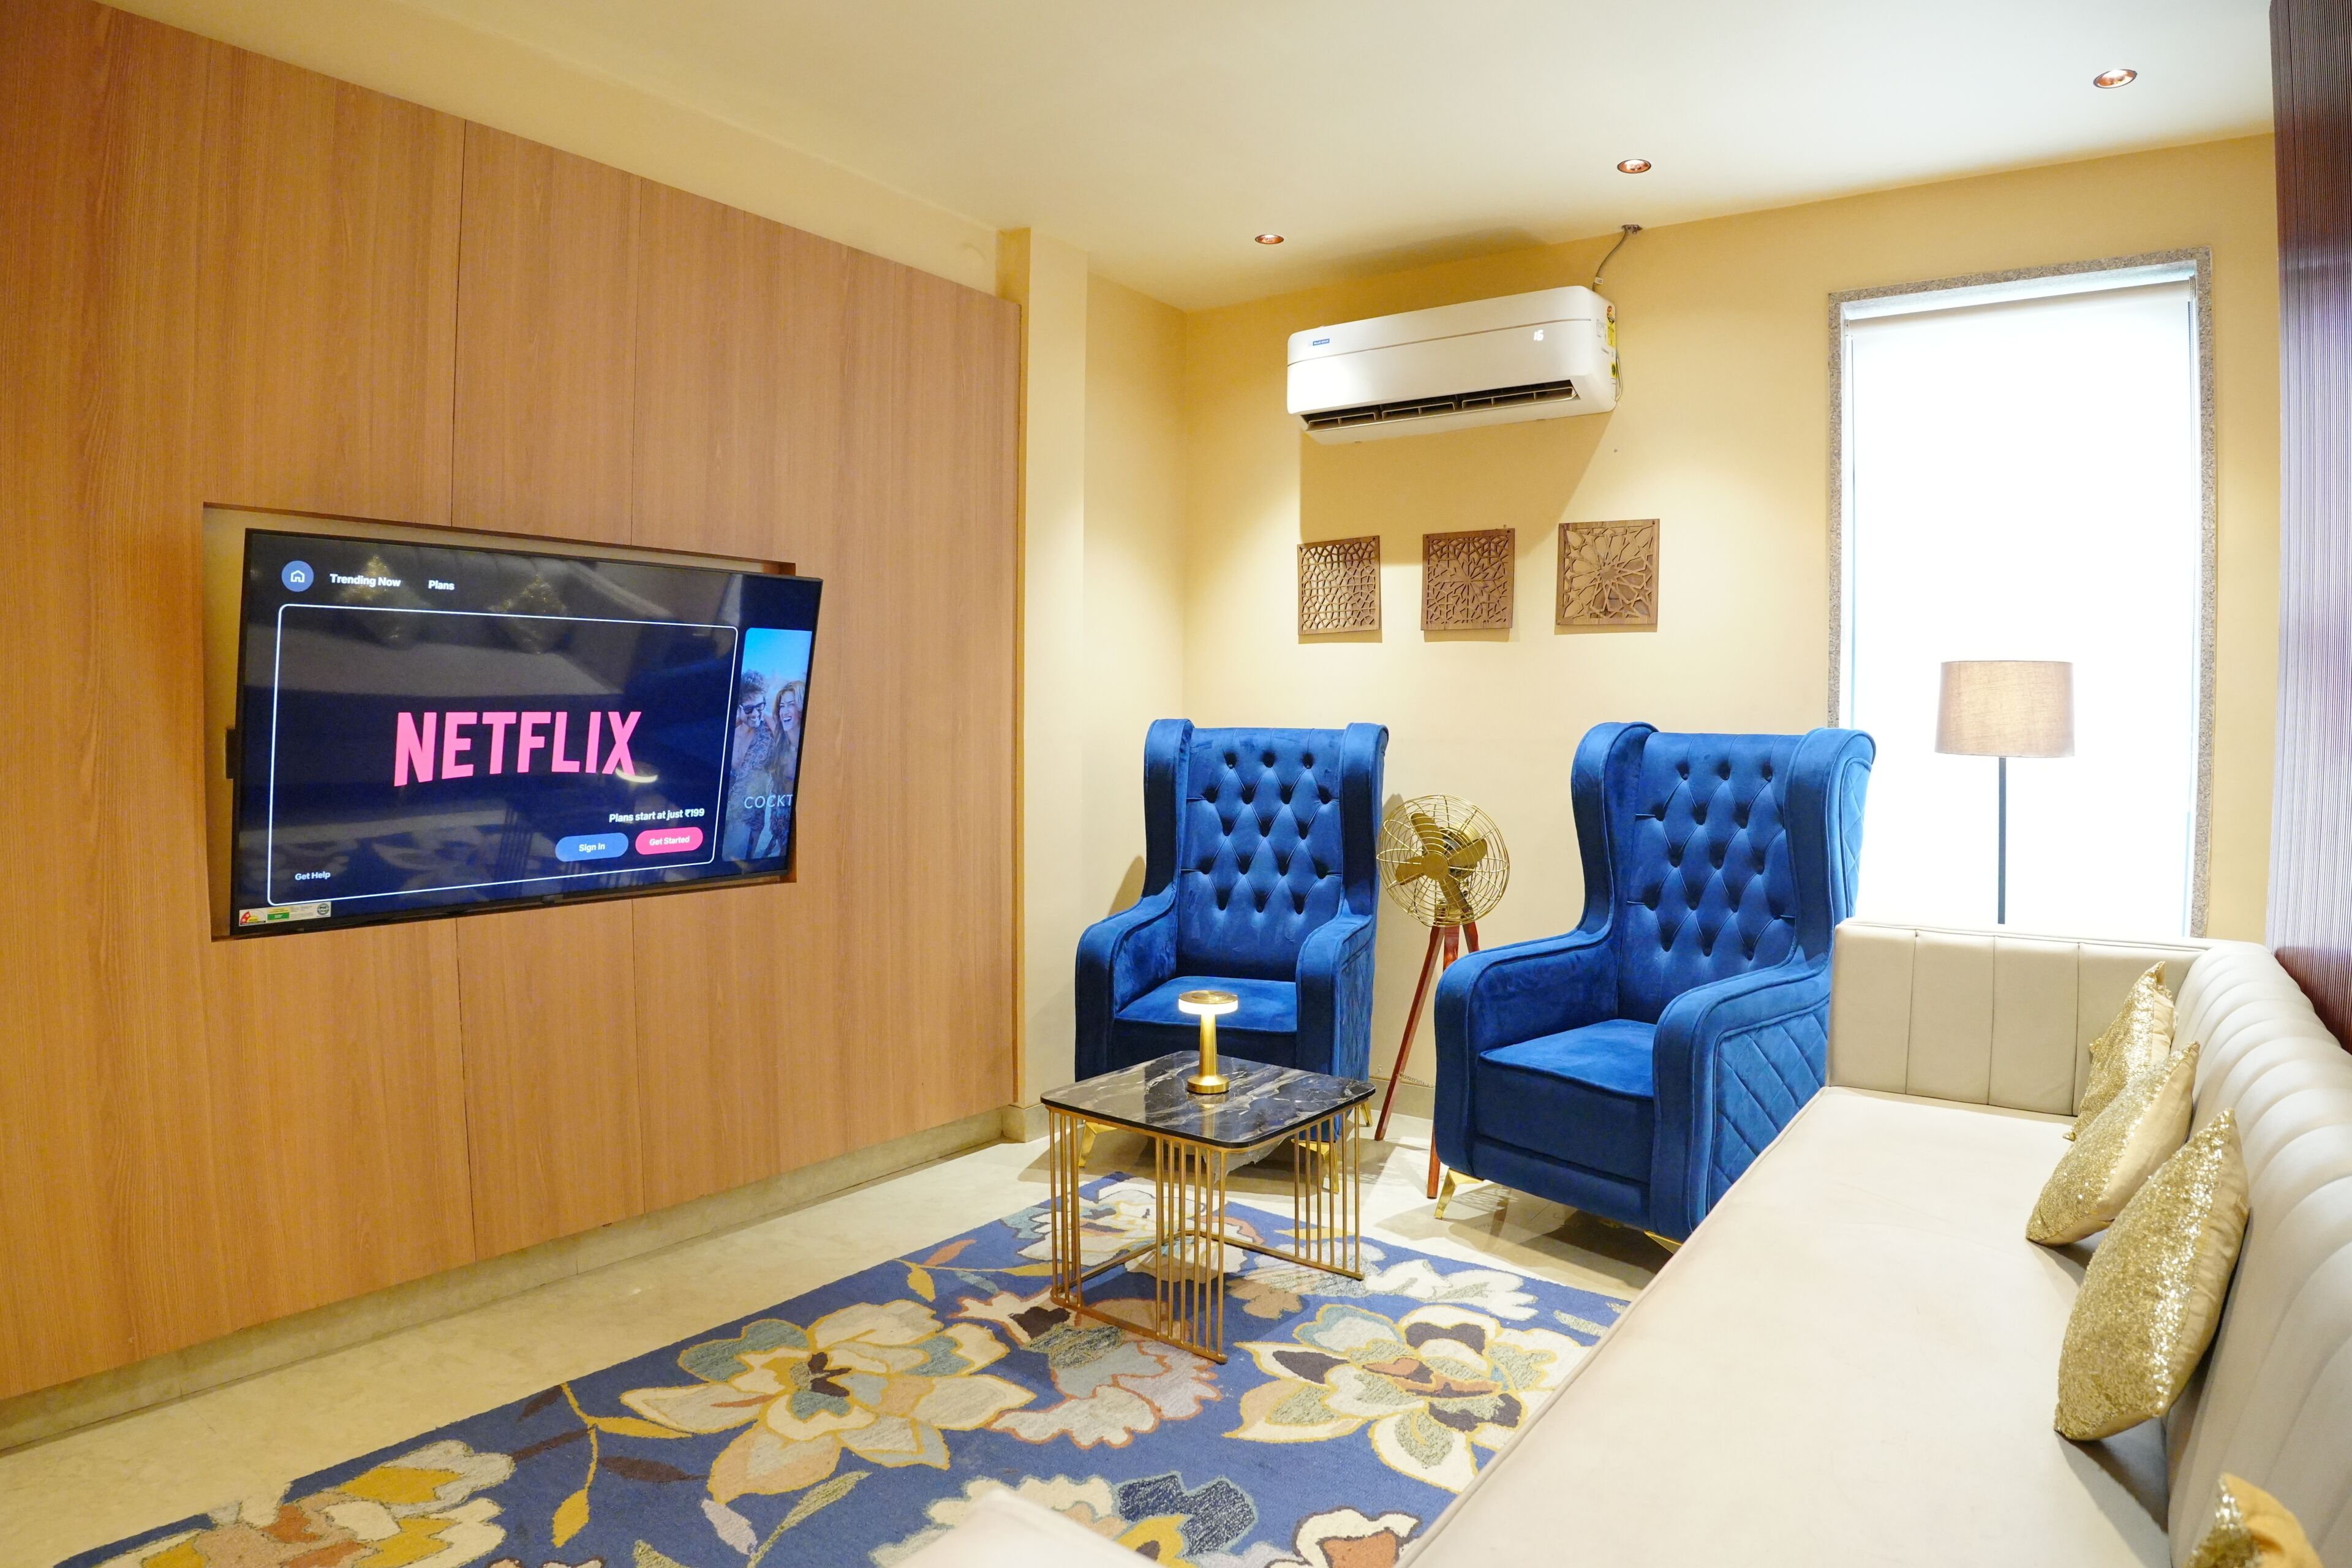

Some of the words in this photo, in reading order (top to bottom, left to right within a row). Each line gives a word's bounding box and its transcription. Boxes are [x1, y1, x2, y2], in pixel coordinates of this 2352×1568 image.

[330, 573, 376, 587] Trending
[377, 577, 401, 587] Now
[428, 580, 454, 590] Plans
[394, 712, 642, 786] NETFLIX
[744, 794, 793, 809] COCKT
[609, 813, 633, 823] Plans
[635, 811, 656, 821] start
[657, 810, 666, 820] at
[666, 809, 684, 820] just
[685, 808, 705, 818] ₹199
[649, 837, 663, 846] Get
[664, 835, 690, 845] Started
[578, 844, 597, 853] Sign
[295, 873, 311, 881] Get
[311, 870, 331, 880] Help
